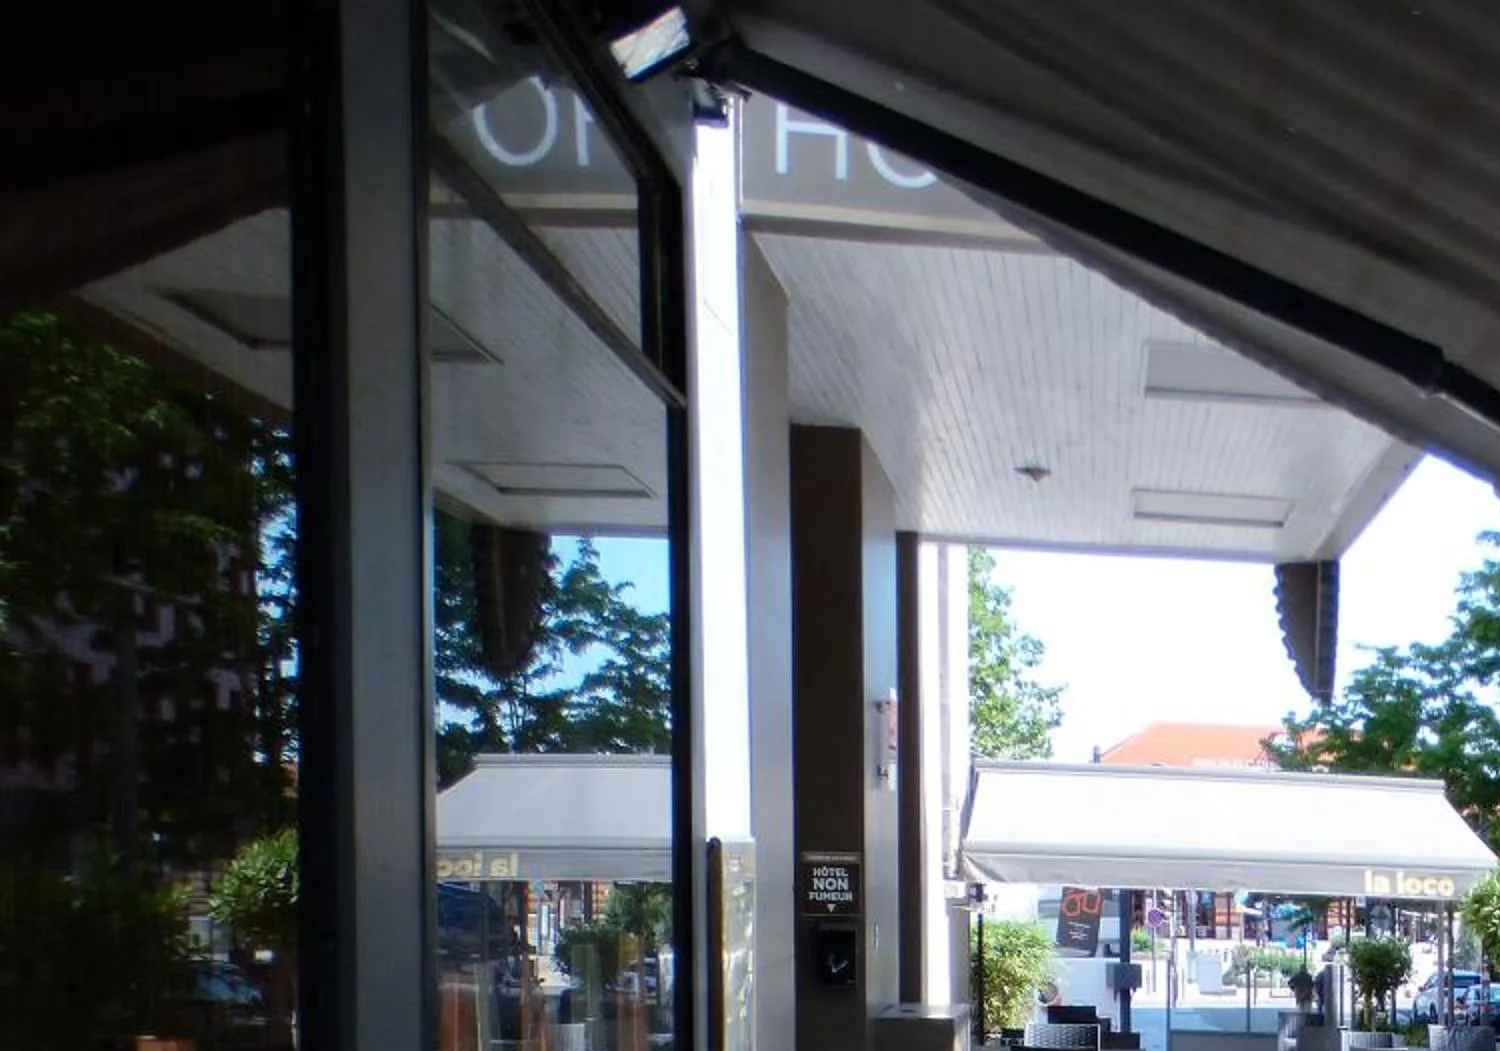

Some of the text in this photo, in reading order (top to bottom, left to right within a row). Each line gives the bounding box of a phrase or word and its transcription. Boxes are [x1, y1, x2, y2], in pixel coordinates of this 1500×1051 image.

[812, 866, 849, 877] HÔTEL
[813, 877, 849, 891] NON
[1365, 869, 1454, 897] la loco
[808, 891, 853, 902] FUMEUR
